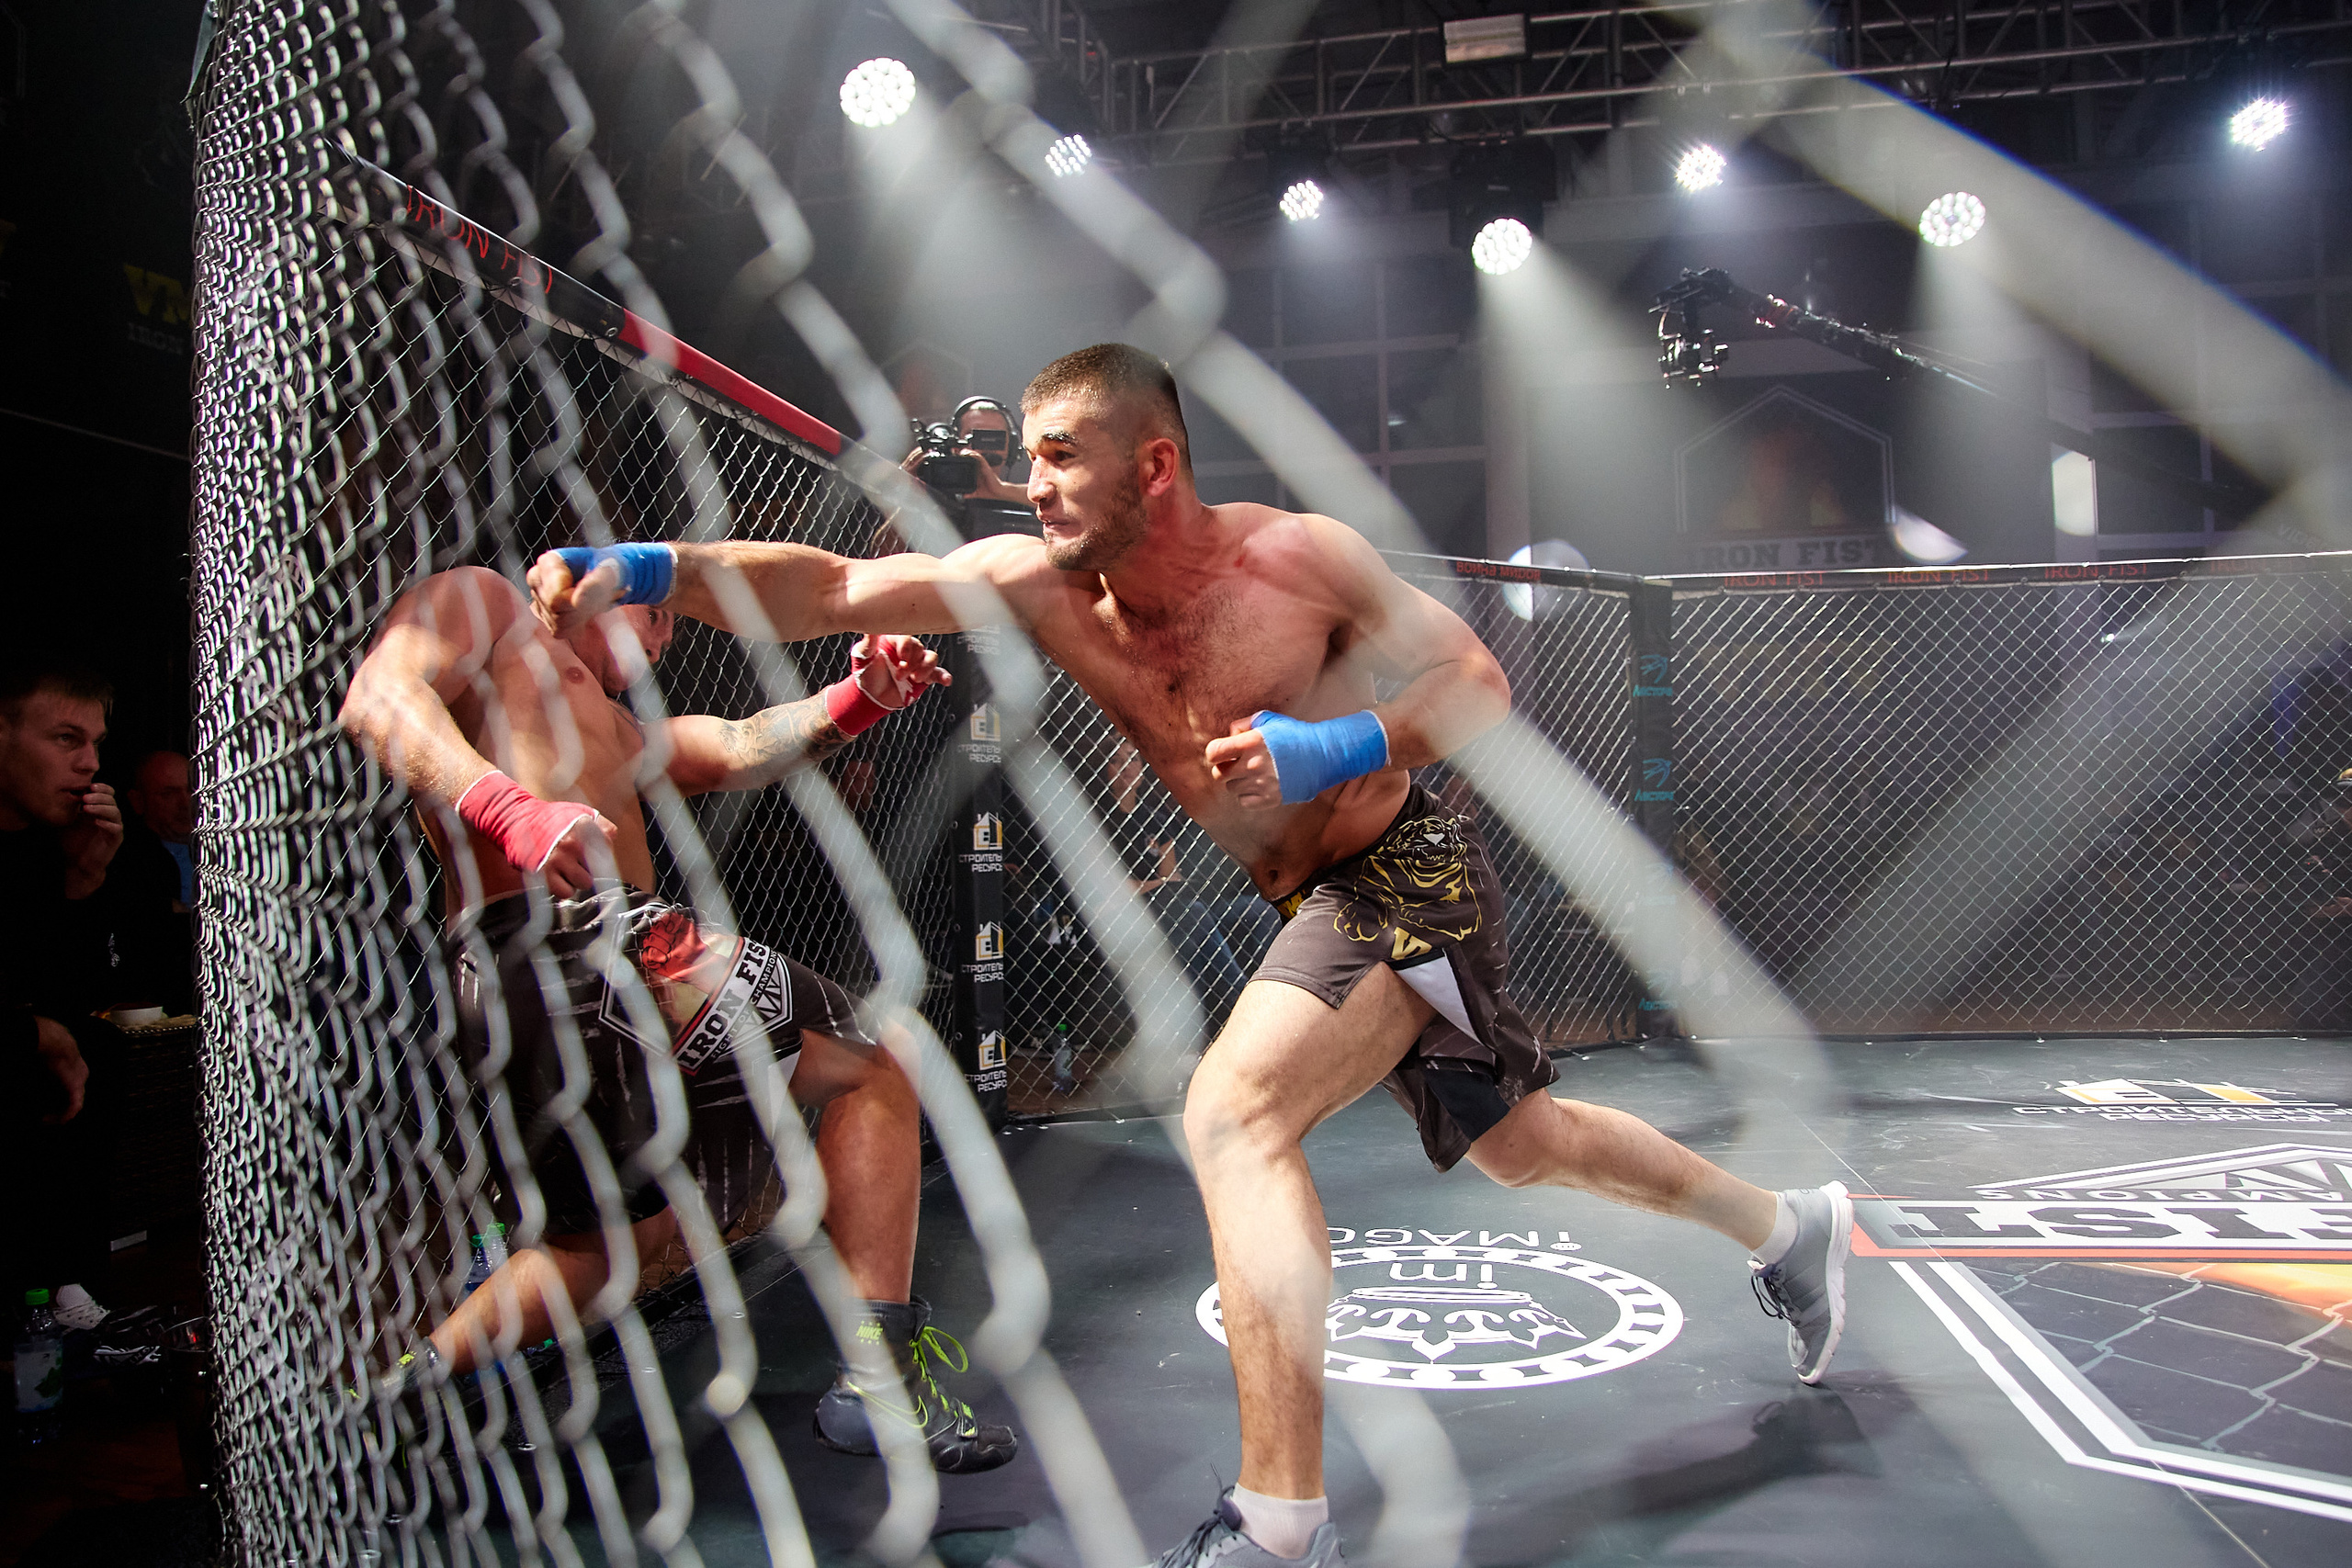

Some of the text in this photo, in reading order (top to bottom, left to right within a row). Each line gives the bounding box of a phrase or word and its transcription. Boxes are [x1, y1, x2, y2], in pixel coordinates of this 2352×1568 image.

[406, 184, 490, 258] IRON
[1888, 569, 1991, 583] IRON FIST
[2045, 563, 2149, 580] IRON FIST
[1724, 572, 1825, 587] IRON FIST
[677, 988, 744, 1067] IRON
[735, 940, 767, 987] FIS
[710, 1028, 738, 1059] FIGHT
[750, 950, 779, 1006] CHAMPIONS
[2012, 1105, 2352, 1116] СТРОИТЕЛЬНЫ
[2098, 1113, 2331, 1122] РЕСУРСЫ
[855, 1325, 883, 1340] NIKE
